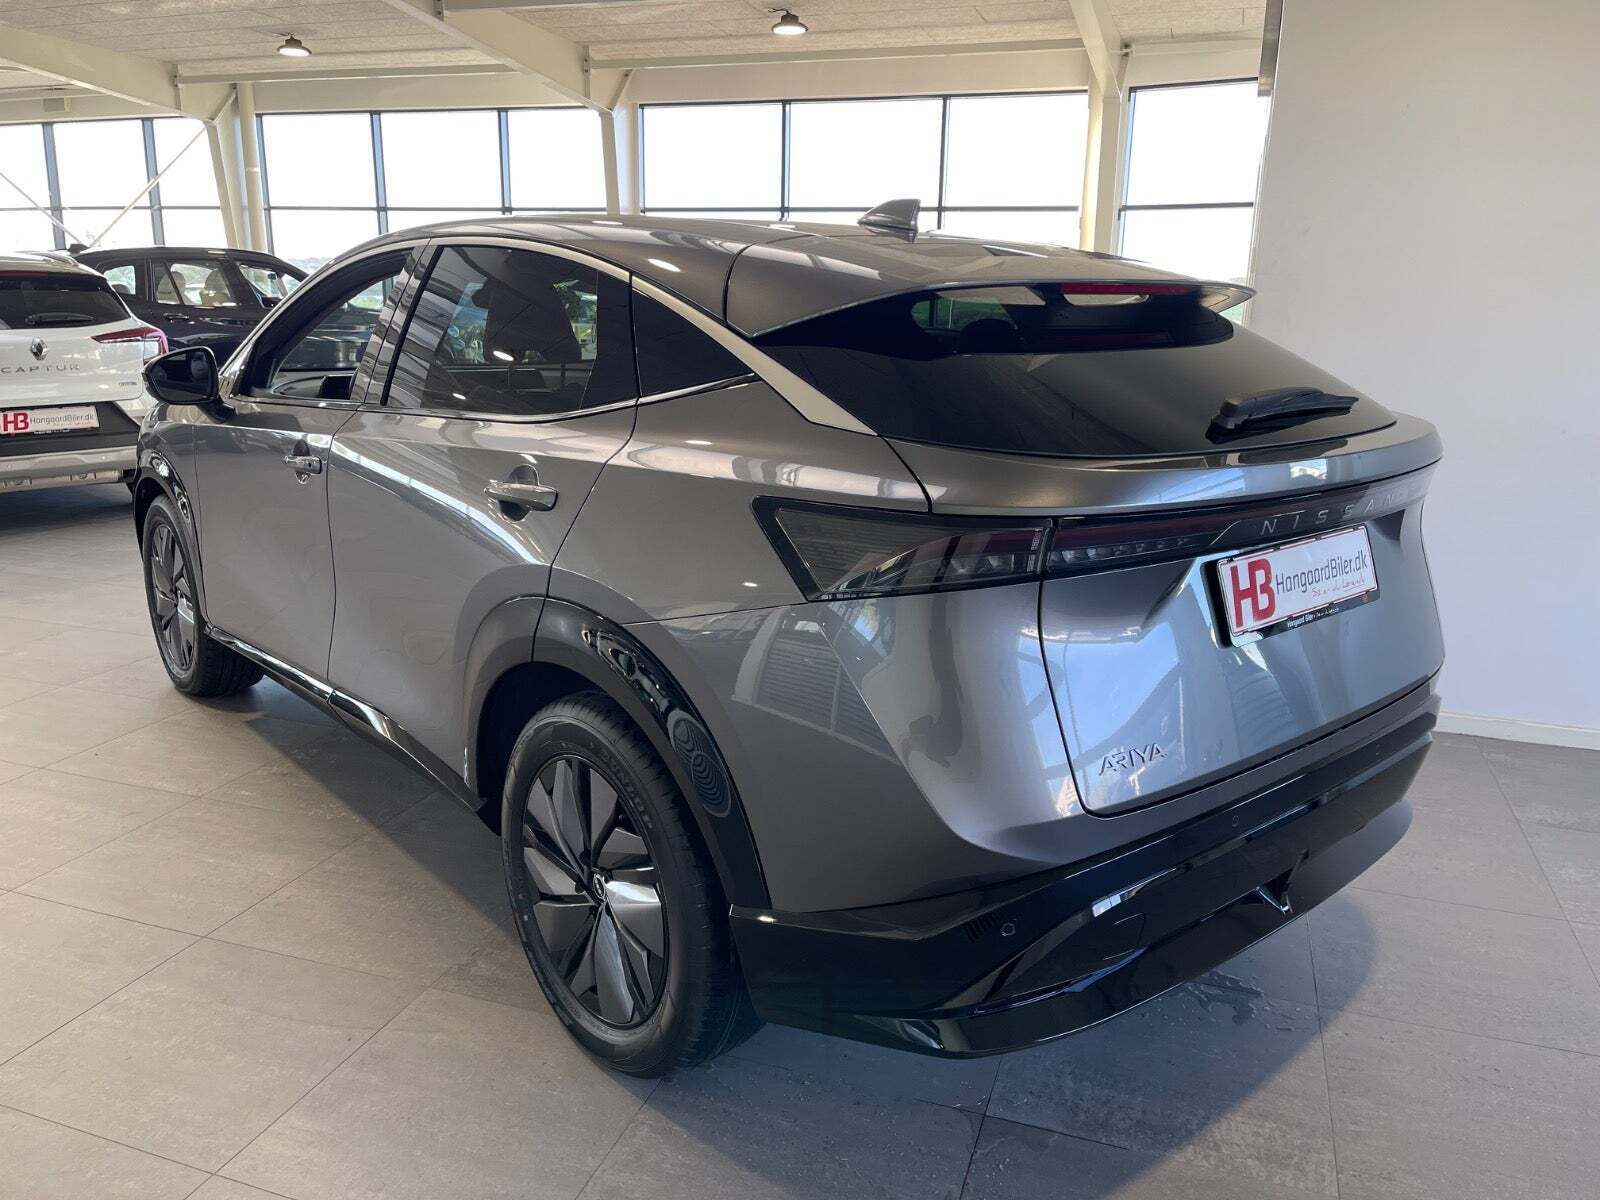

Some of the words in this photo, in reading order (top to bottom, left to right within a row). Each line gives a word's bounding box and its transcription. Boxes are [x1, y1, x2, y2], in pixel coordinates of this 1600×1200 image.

[1, 363, 80, 374] CAPTUR
[3, 412, 30, 432] HB
[1260, 494, 1394, 535] NISSAN
[1230, 558, 1276, 628] HB
[1099, 742, 1167, 776] ARIYA
